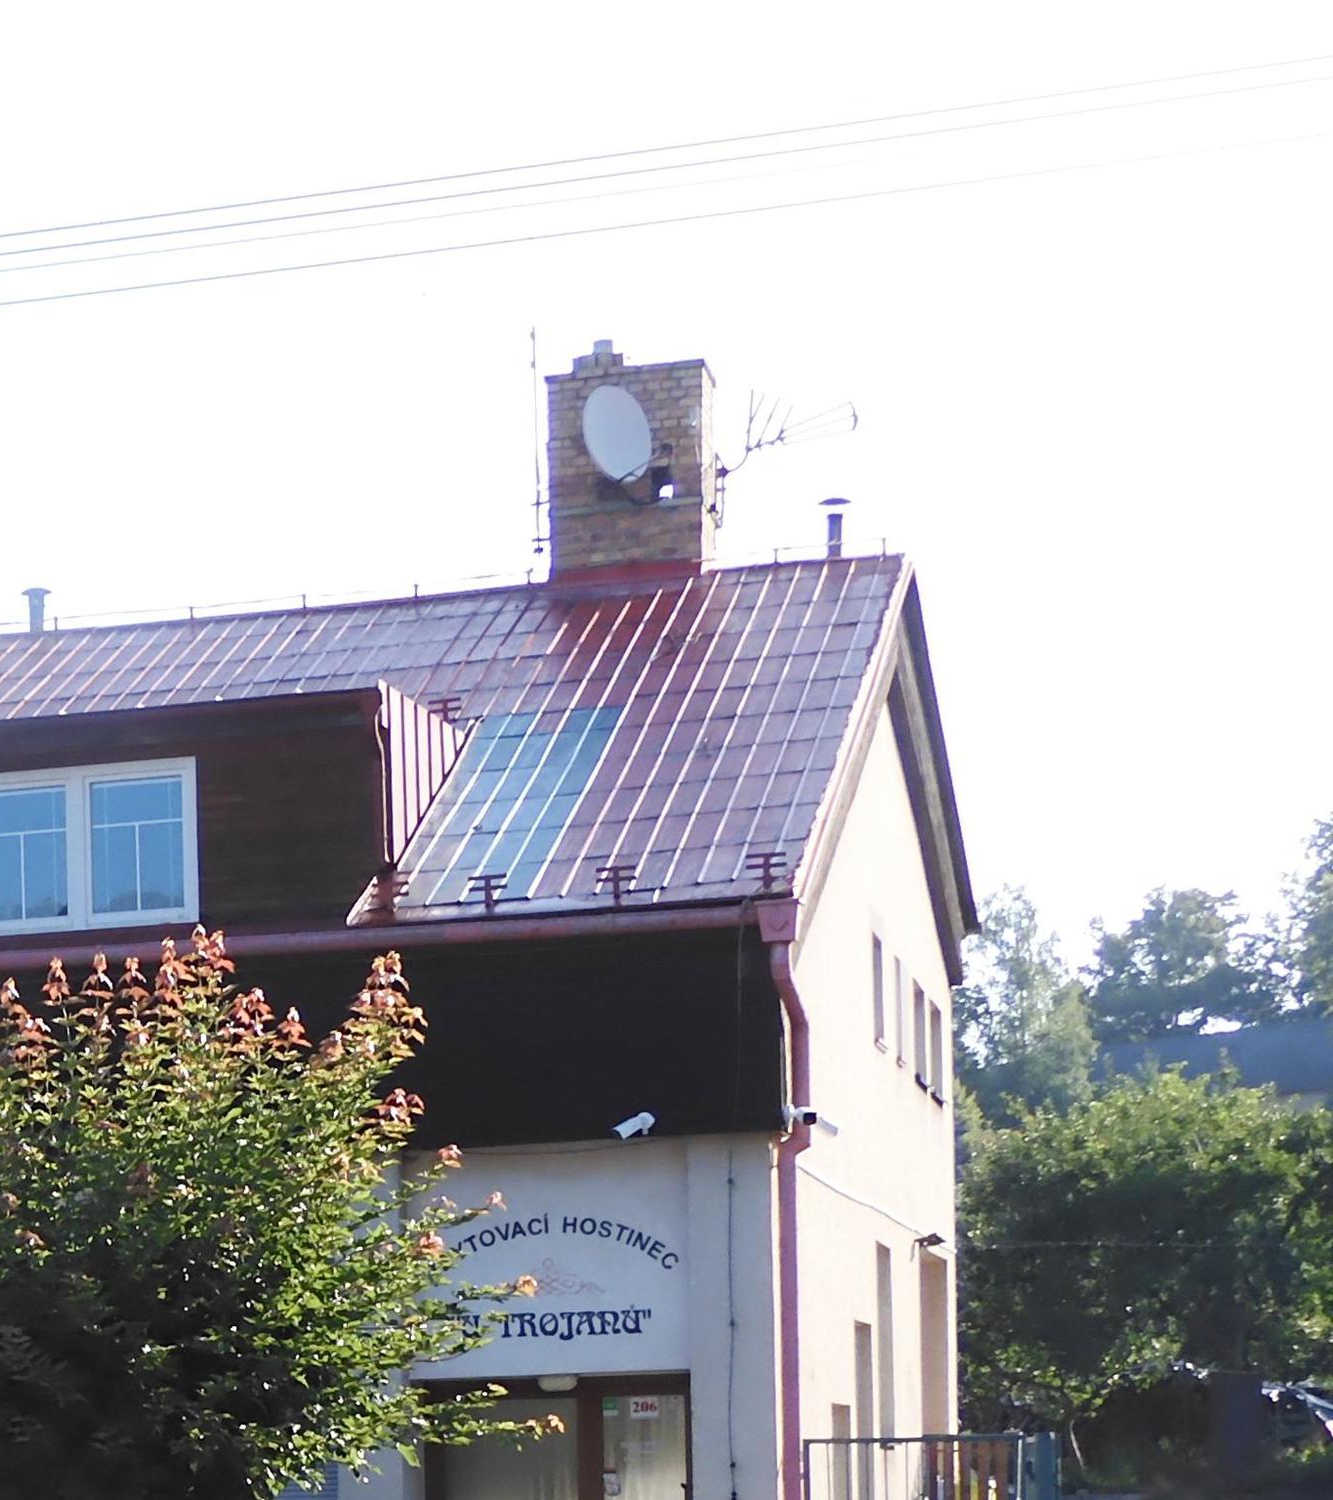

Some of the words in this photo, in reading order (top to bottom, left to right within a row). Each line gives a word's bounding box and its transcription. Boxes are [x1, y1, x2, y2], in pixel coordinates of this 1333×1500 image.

[449, 1213, 550, 1259] YTOVACÍ
[562, 1216, 679, 1270] HOSTINEC
[632, 1400, 658, 1414] 206
